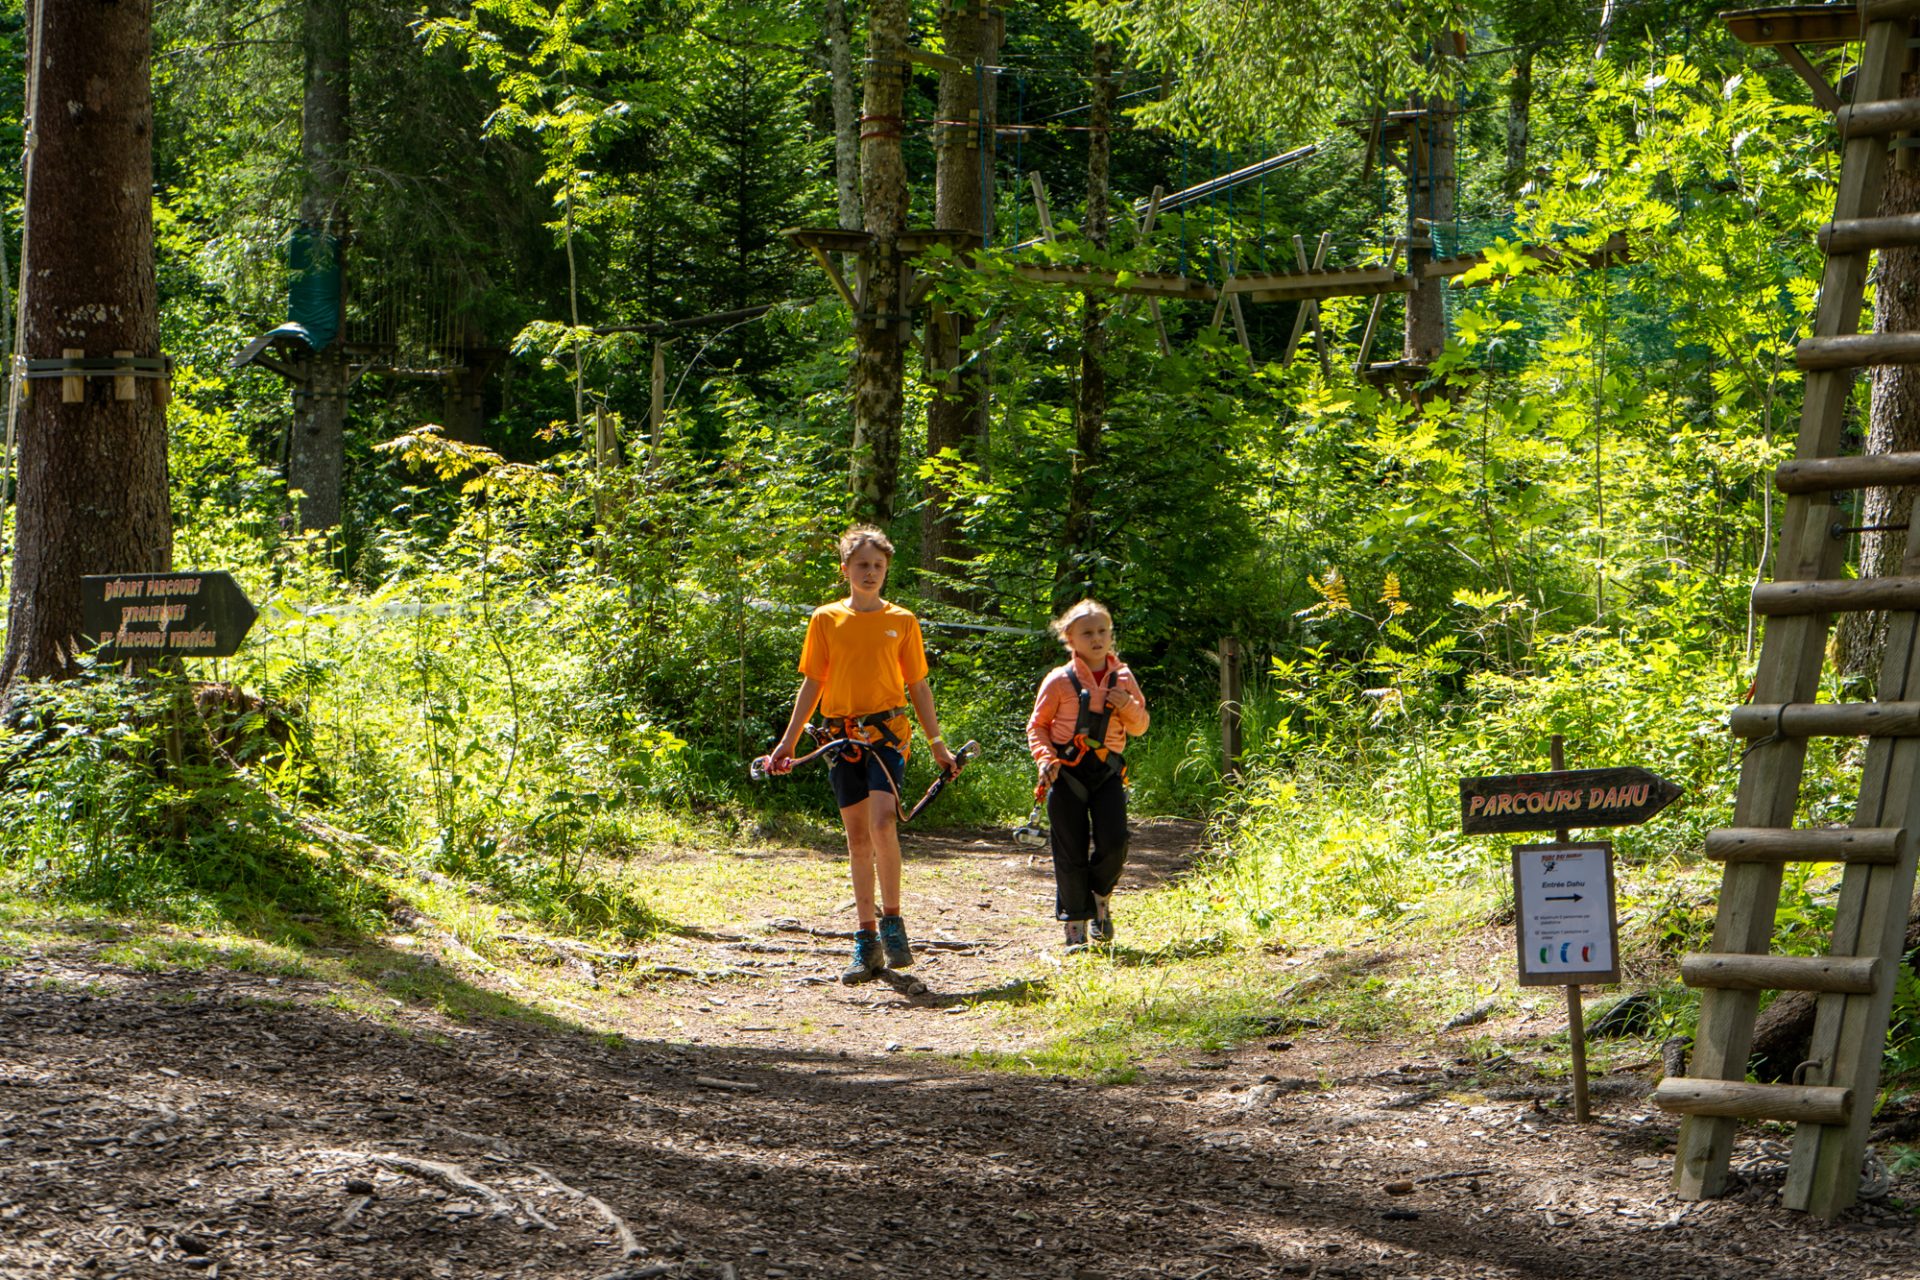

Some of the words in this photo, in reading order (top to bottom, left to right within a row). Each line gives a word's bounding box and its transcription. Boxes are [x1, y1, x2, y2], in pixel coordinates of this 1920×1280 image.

[104, 578, 144, 602] DÉPART
[146, 578, 202, 597] PARCOURS
[115, 632, 167, 648] PARCOURS
[169, 631, 216, 648] VERTICAL
[1469, 789, 1583, 817] PARCOURS
[1588, 784, 1650, 810] DAHU
[1542, 881, 1565, 889] Entrée
